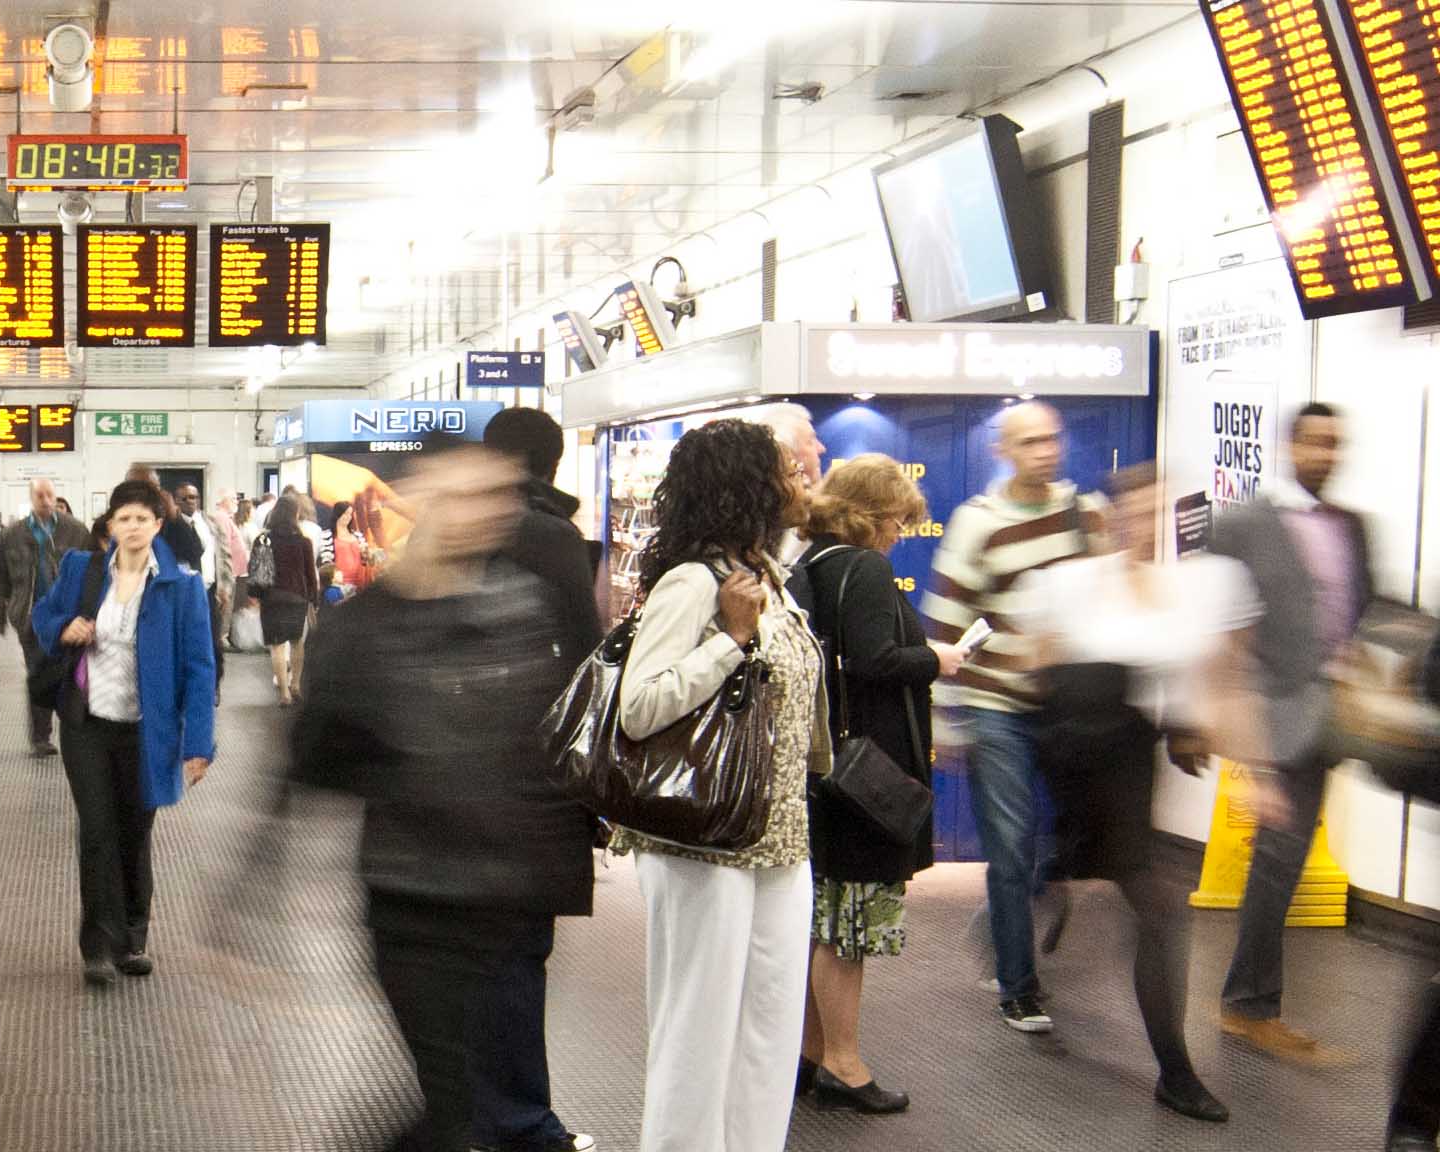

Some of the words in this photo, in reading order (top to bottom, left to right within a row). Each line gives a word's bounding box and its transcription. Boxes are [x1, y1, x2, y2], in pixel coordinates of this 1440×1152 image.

[112, 337, 160, 346] Departures
[470, 354, 509, 364] Platforms
[966, 332, 1122, 386] Express
[1182, 344, 1200, 364] FACE
[478, 369, 485, 378] 3
[486, 369, 501, 378] and
[502, 369, 508, 378] 4
[140, 415, 164, 424] FIRE
[351, 407, 466, 434] NERO
[1213, 402, 1263, 439] DIGBY
[141, 424, 163, 434] EXIT
[370, 442, 422, 452] ESPRESSO
[1214, 438, 1263, 474] JONES
